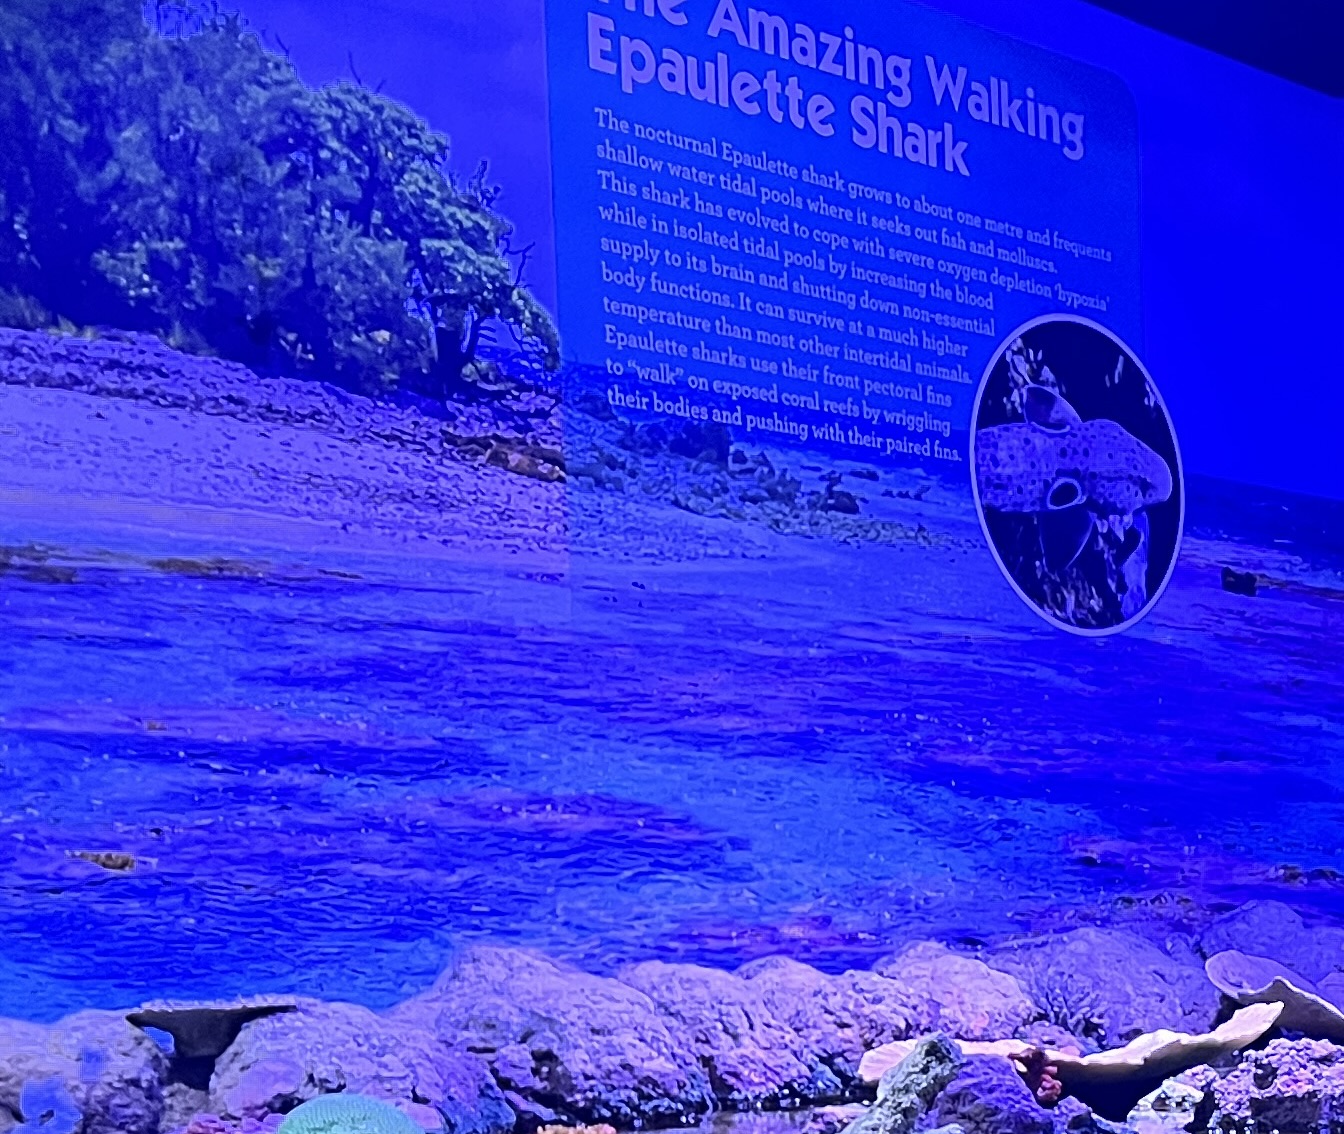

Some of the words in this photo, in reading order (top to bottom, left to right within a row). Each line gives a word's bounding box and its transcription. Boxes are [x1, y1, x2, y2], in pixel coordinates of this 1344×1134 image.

[587, 12, 836, 136] Epaulette
[851, 95, 970, 176] Shark
[707, 0, 911, 106] Amazing
[925, 56, 1085, 160] Walking
[594, 107, 629, 133] The
[634, 124, 717, 157] nocturnal
[721, 142, 798, 179] Epaulette
[802, 165, 845, 191] shark
[848, 183, 892, 204] grows
[895, 192, 910, 209] to
[914, 195, 953, 220] about
[957, 212, 981, 228] one
[984, 219, 1023, 239] metre
[1026, 229, 1050, 246] and
[1053, 231, 1111, 261] frequents
[597, 139, 663, 171] shallow
[667, 163, 715, 186] water
[719, 173, 757, 197] tidal
[760, 187, 803, 209] pools
[806, 195, 853, 221] where
[857, 207, 868, 225] it
[871, 215, 911, 236] seeks
[915, 227, 938, 243] out
[941, 228, 966, 250] fish
[970, 240, 994, 257] and
[997, 247, 1058, 273] molluscs.
[598, 202, 647, 229] while
[652, 214, 669, 234] in
[673, 219, 739, 250] isolated
[743, 237, 780, 260] tidal
[783, 250, 825, 271] pools
[828, 254, 847, 279] by
[851, 262, 926, 298] increasing
[930, 279, 952, 300] the
[955, 284, 994, 310] blood
